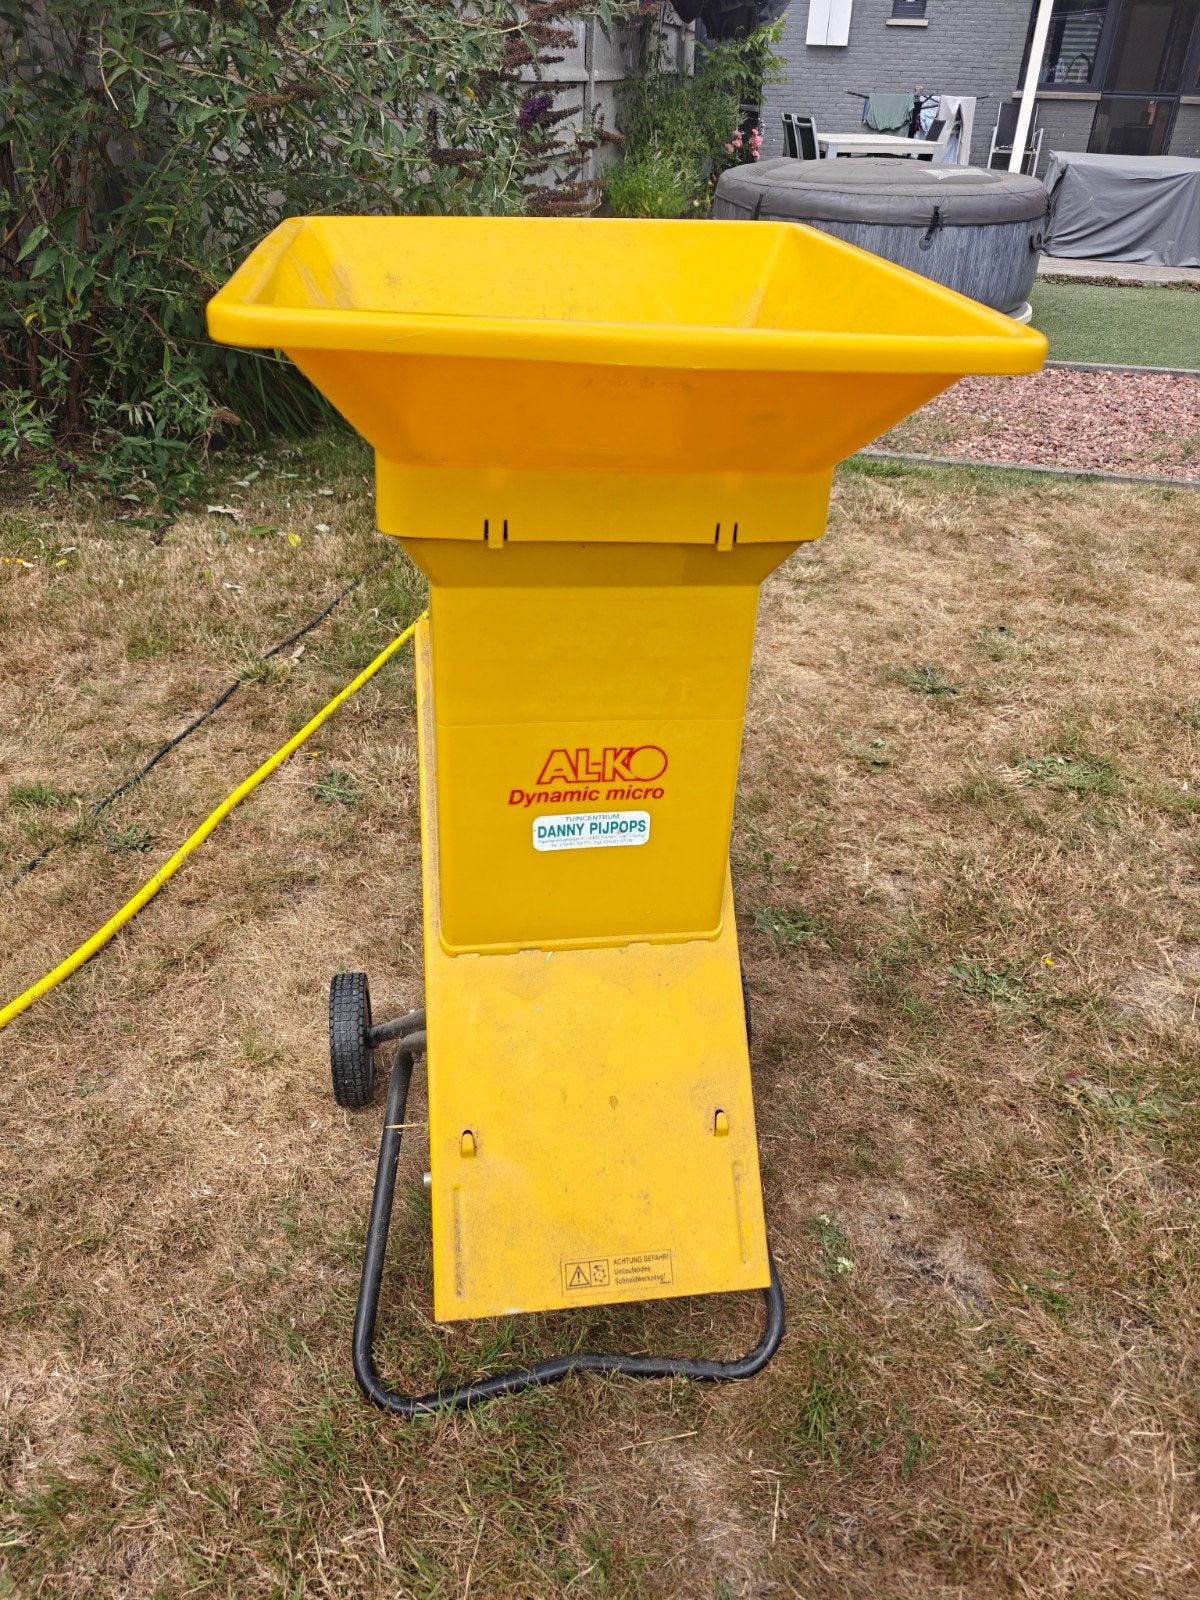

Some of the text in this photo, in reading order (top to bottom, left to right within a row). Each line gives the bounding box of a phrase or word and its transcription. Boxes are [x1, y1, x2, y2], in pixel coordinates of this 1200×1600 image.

[536, 745, 668, 785] AL-KO
[508, 784, 665, 808] Dynamic micro
[565, 813, 620, 822] TUINCENTRUM
[537, 822, 585, 839] DANNY
[589, 819, 647, 835] PIJPOPS
[613, 1253, 669, 1265] ACHTUNG GEFAHR!
